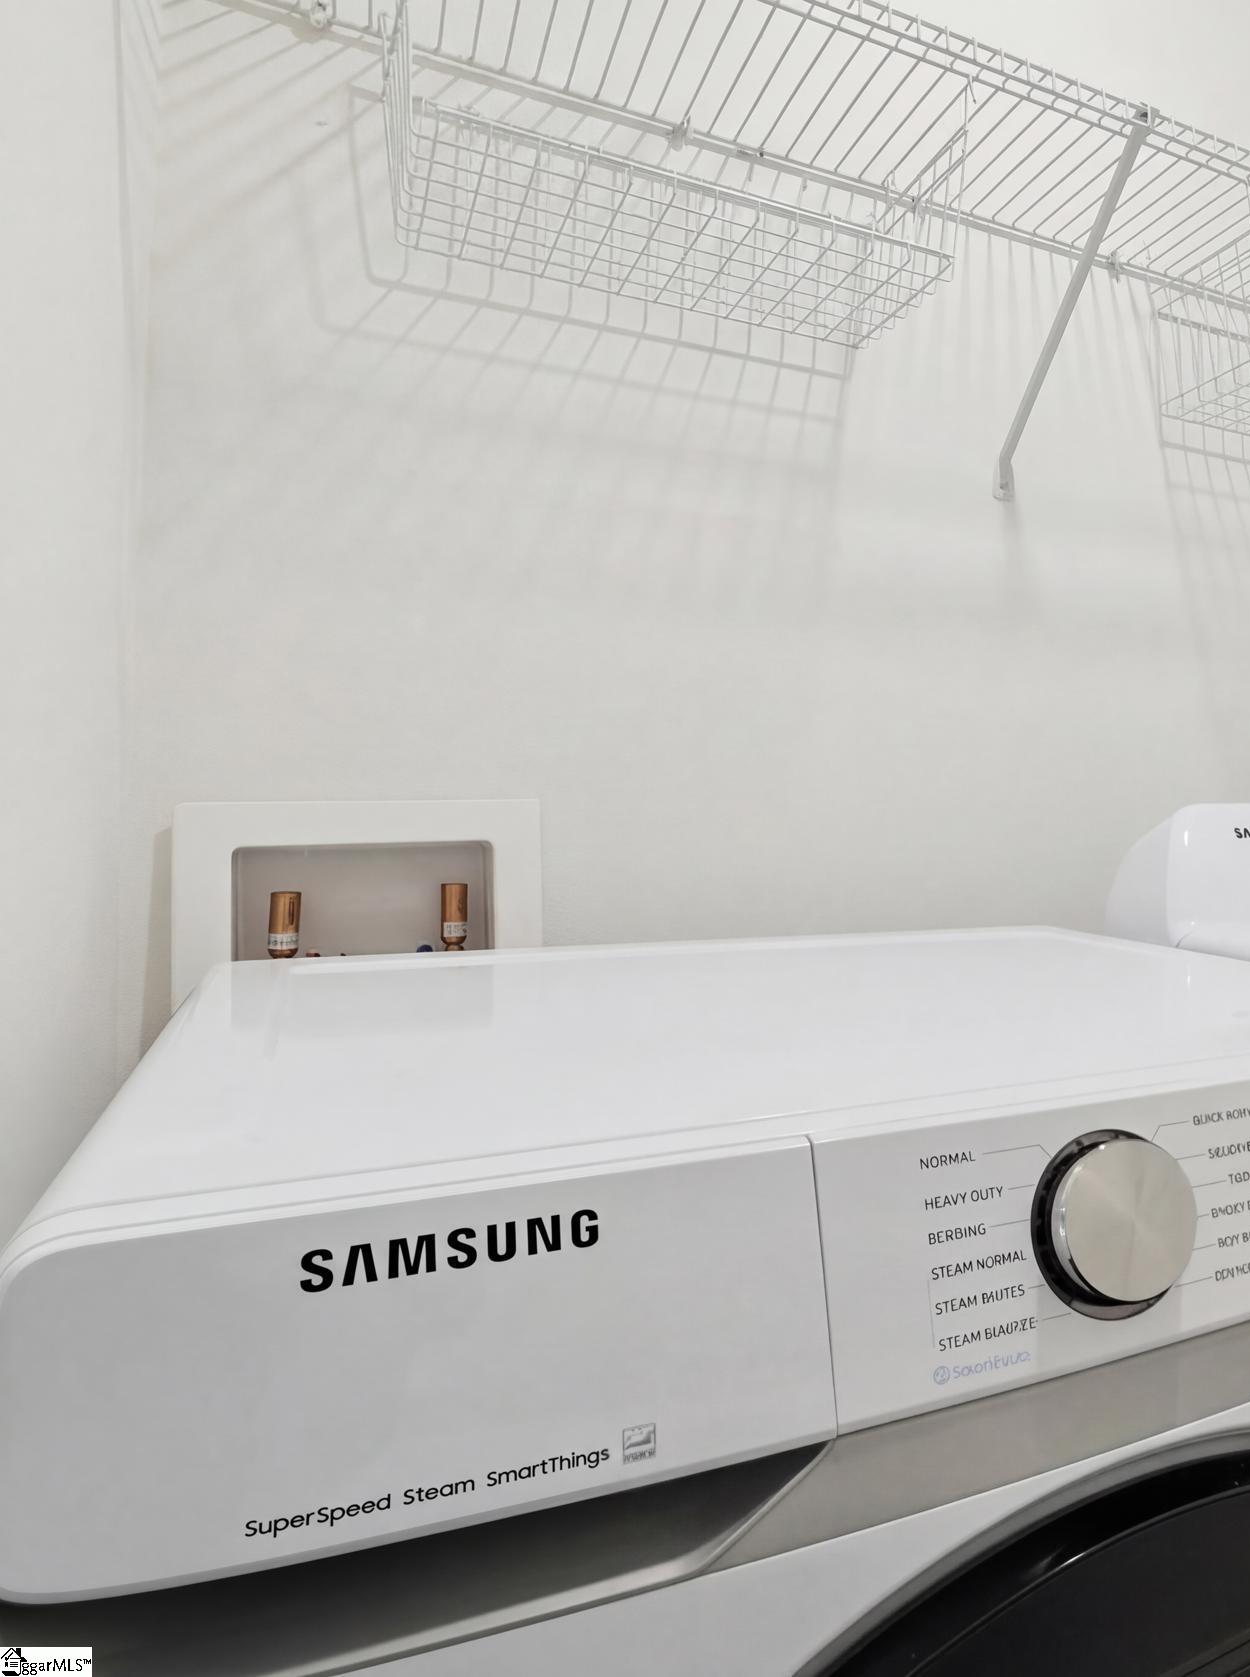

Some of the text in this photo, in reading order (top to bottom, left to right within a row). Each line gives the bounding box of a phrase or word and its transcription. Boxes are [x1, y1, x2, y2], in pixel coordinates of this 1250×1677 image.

[919, 1150, 977, 1170] NORMAL
[924, 1192, 967, 1211] HEAVY
[928, 1222, 987, 1245] BERBING
[300, 1208, 600, 1294] SAMSUNG
[931, 1249, 1027, 1281] STEAM NORMAL
[935, 1294, 978, 1316] STEAM
[938, 1329, 981, 1352] STEAM
[244, 1446, 610, 1538] SuperSpeed Steam SmartThings
